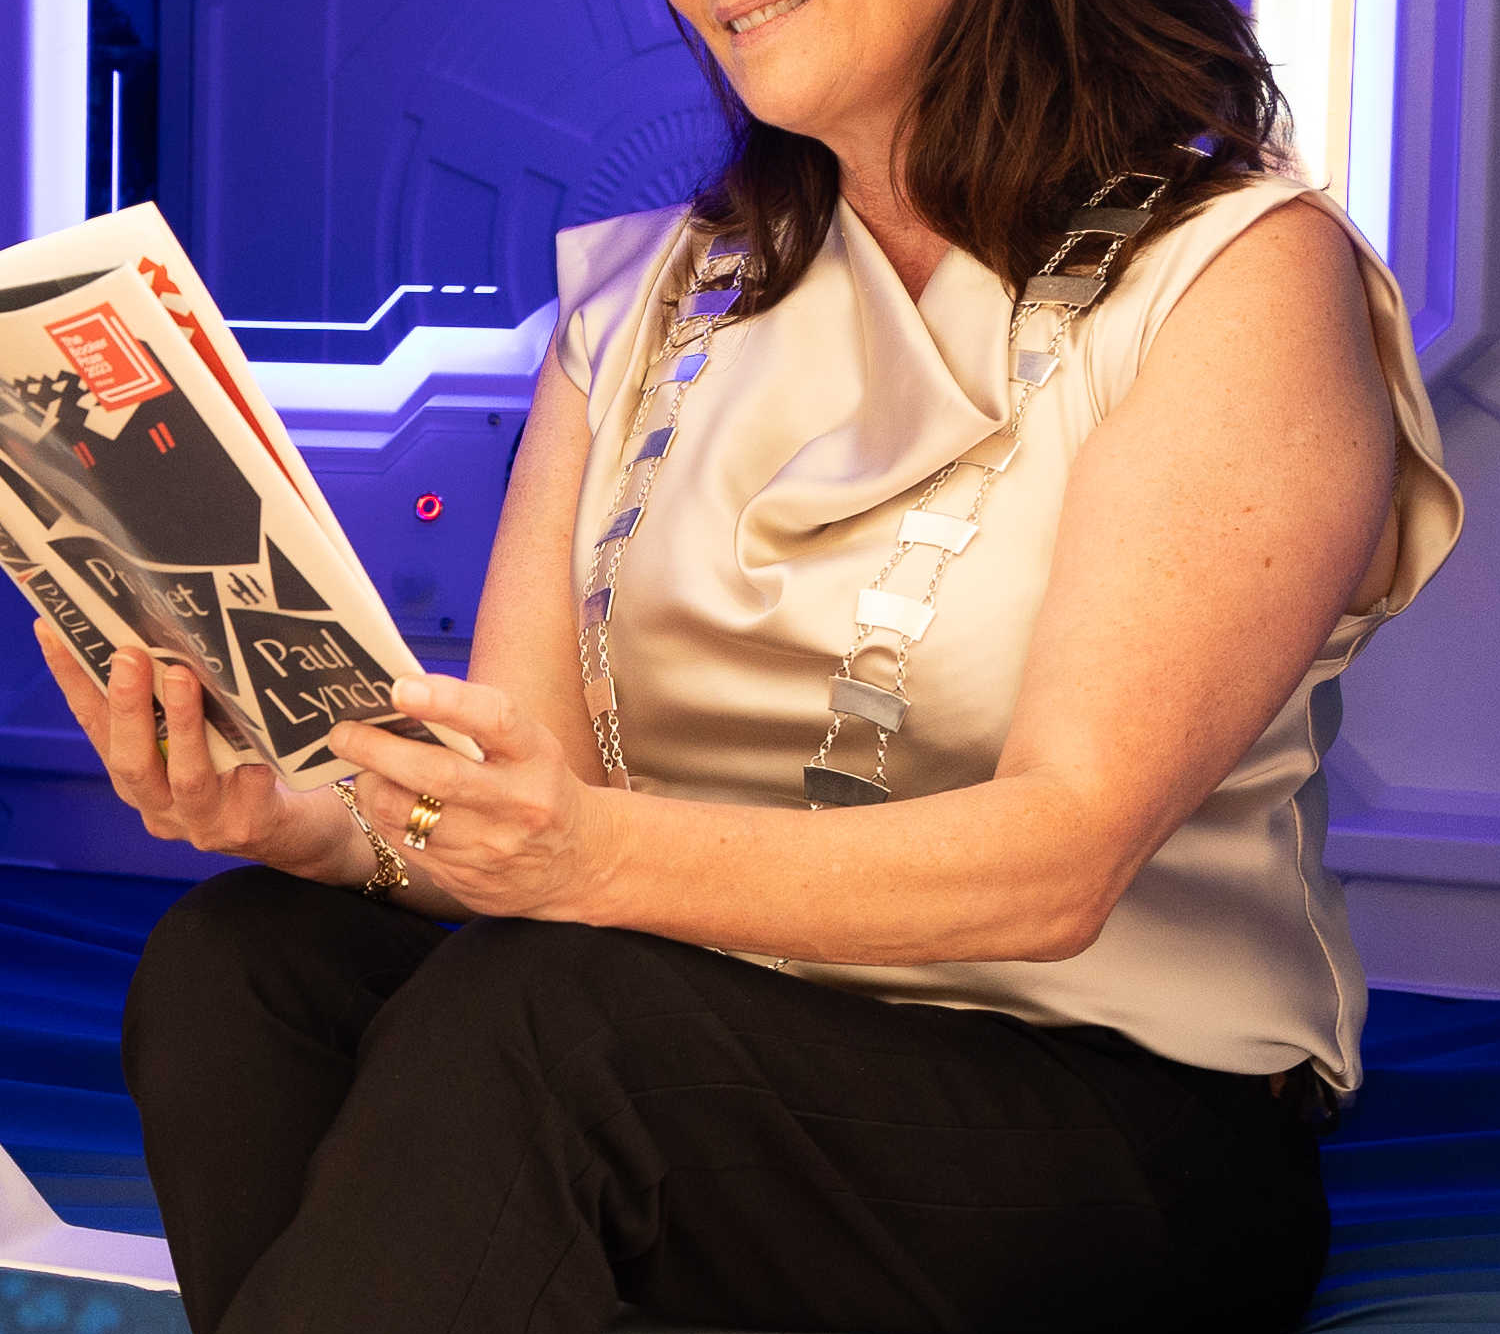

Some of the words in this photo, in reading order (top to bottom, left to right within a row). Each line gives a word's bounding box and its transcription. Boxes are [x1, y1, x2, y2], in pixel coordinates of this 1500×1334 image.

[34, 582, 85, 645] PAUL
[253, 628, 355, 678] Paul
[264, 670, 395, 725] Lynch
